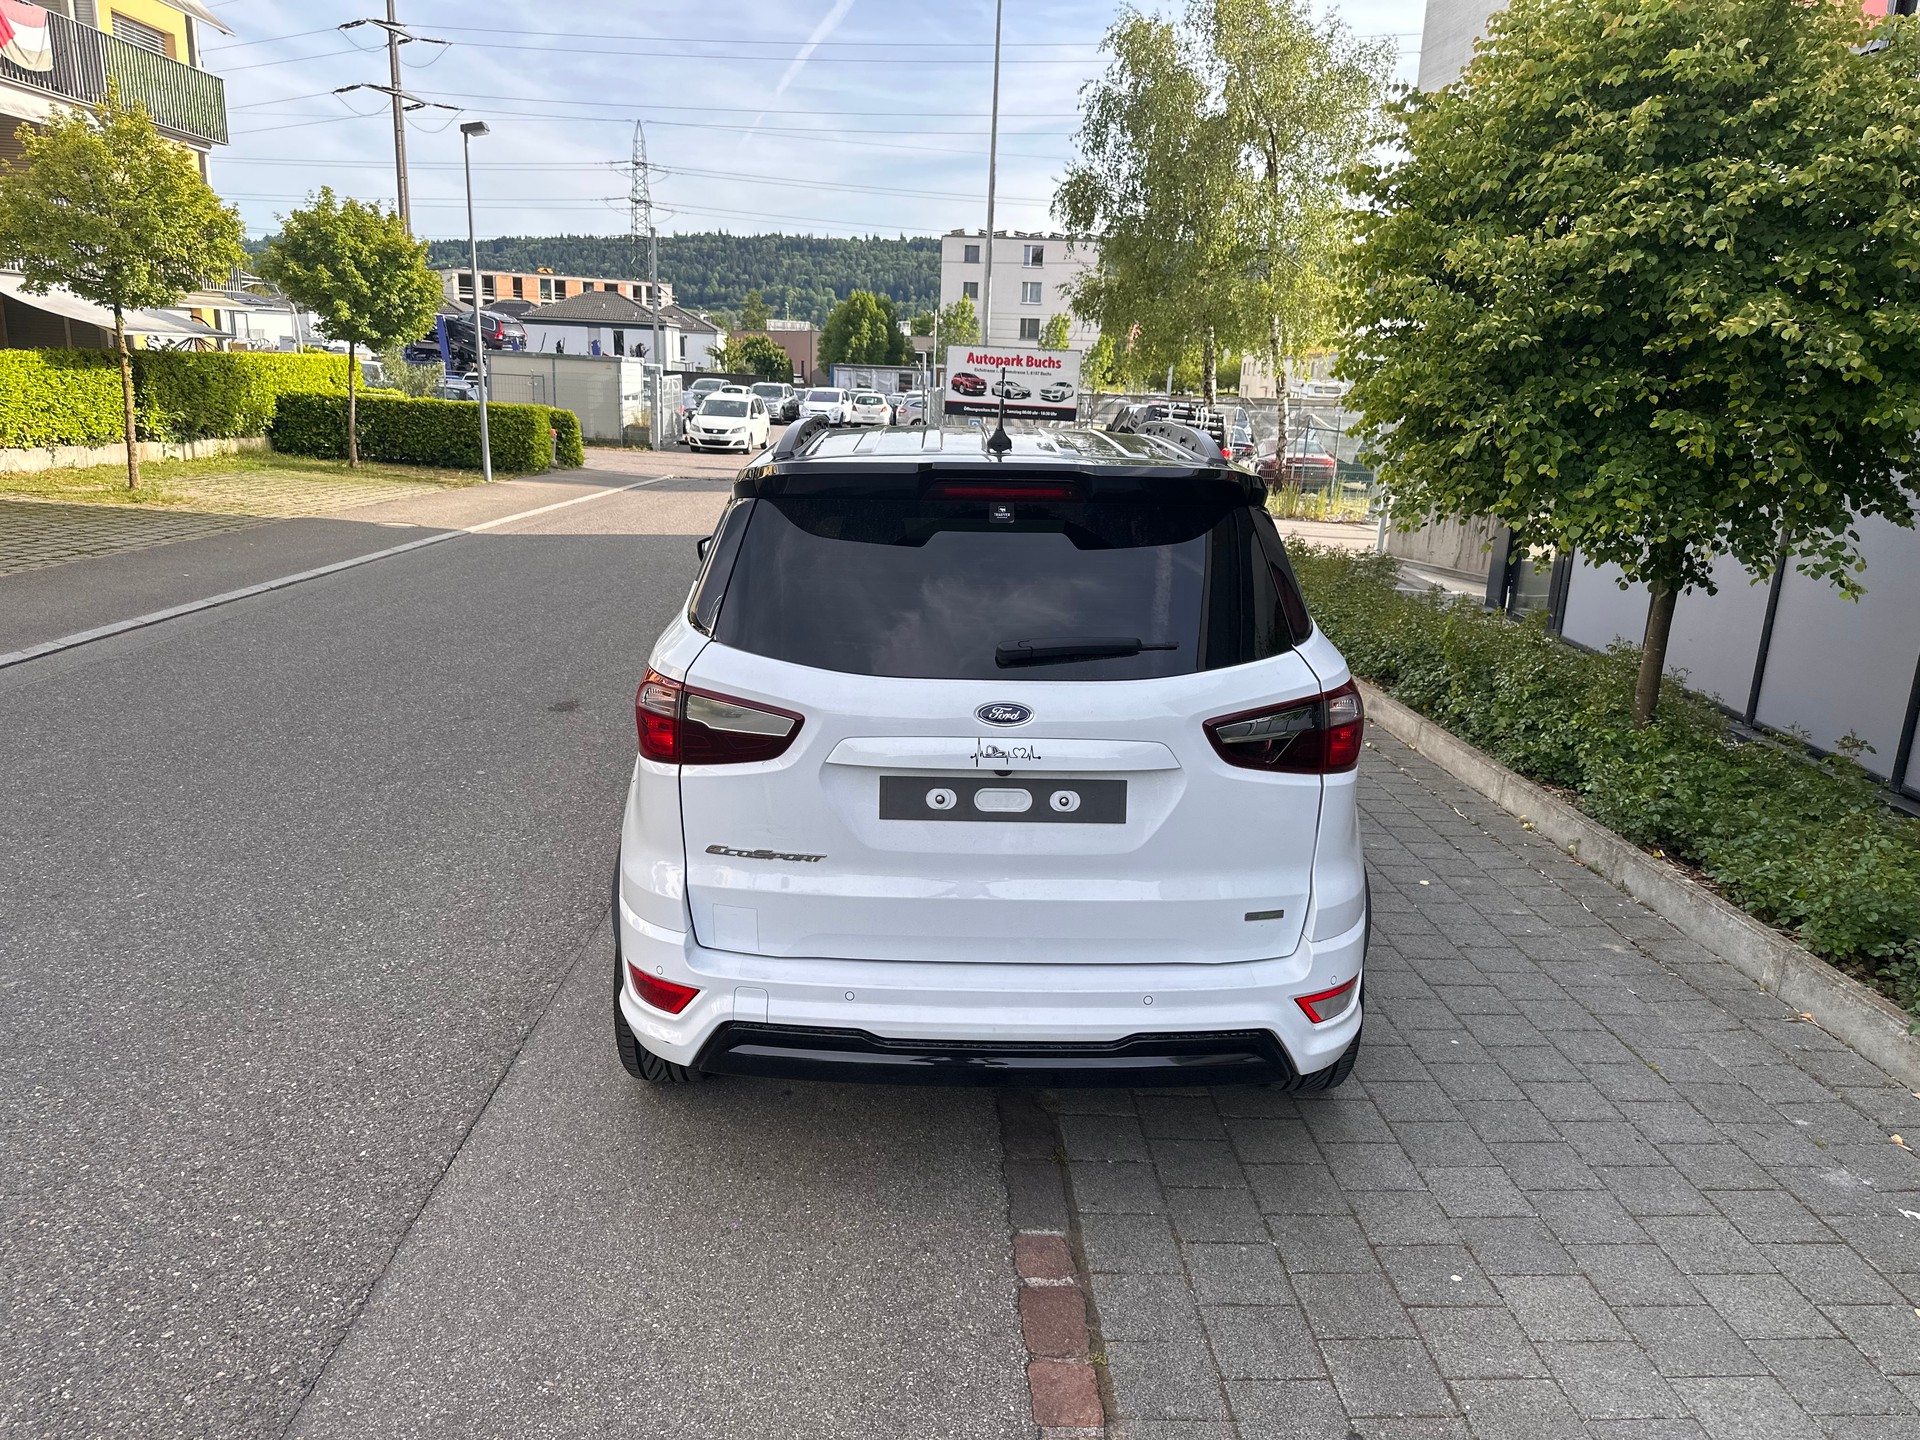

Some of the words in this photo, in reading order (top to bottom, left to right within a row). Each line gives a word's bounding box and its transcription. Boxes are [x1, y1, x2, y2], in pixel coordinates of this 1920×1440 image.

[967, 352, 1023, 368] Autopark
[1026, 356, 1062, 369] Buchs
[989, 707, 1020, 720] Ford
